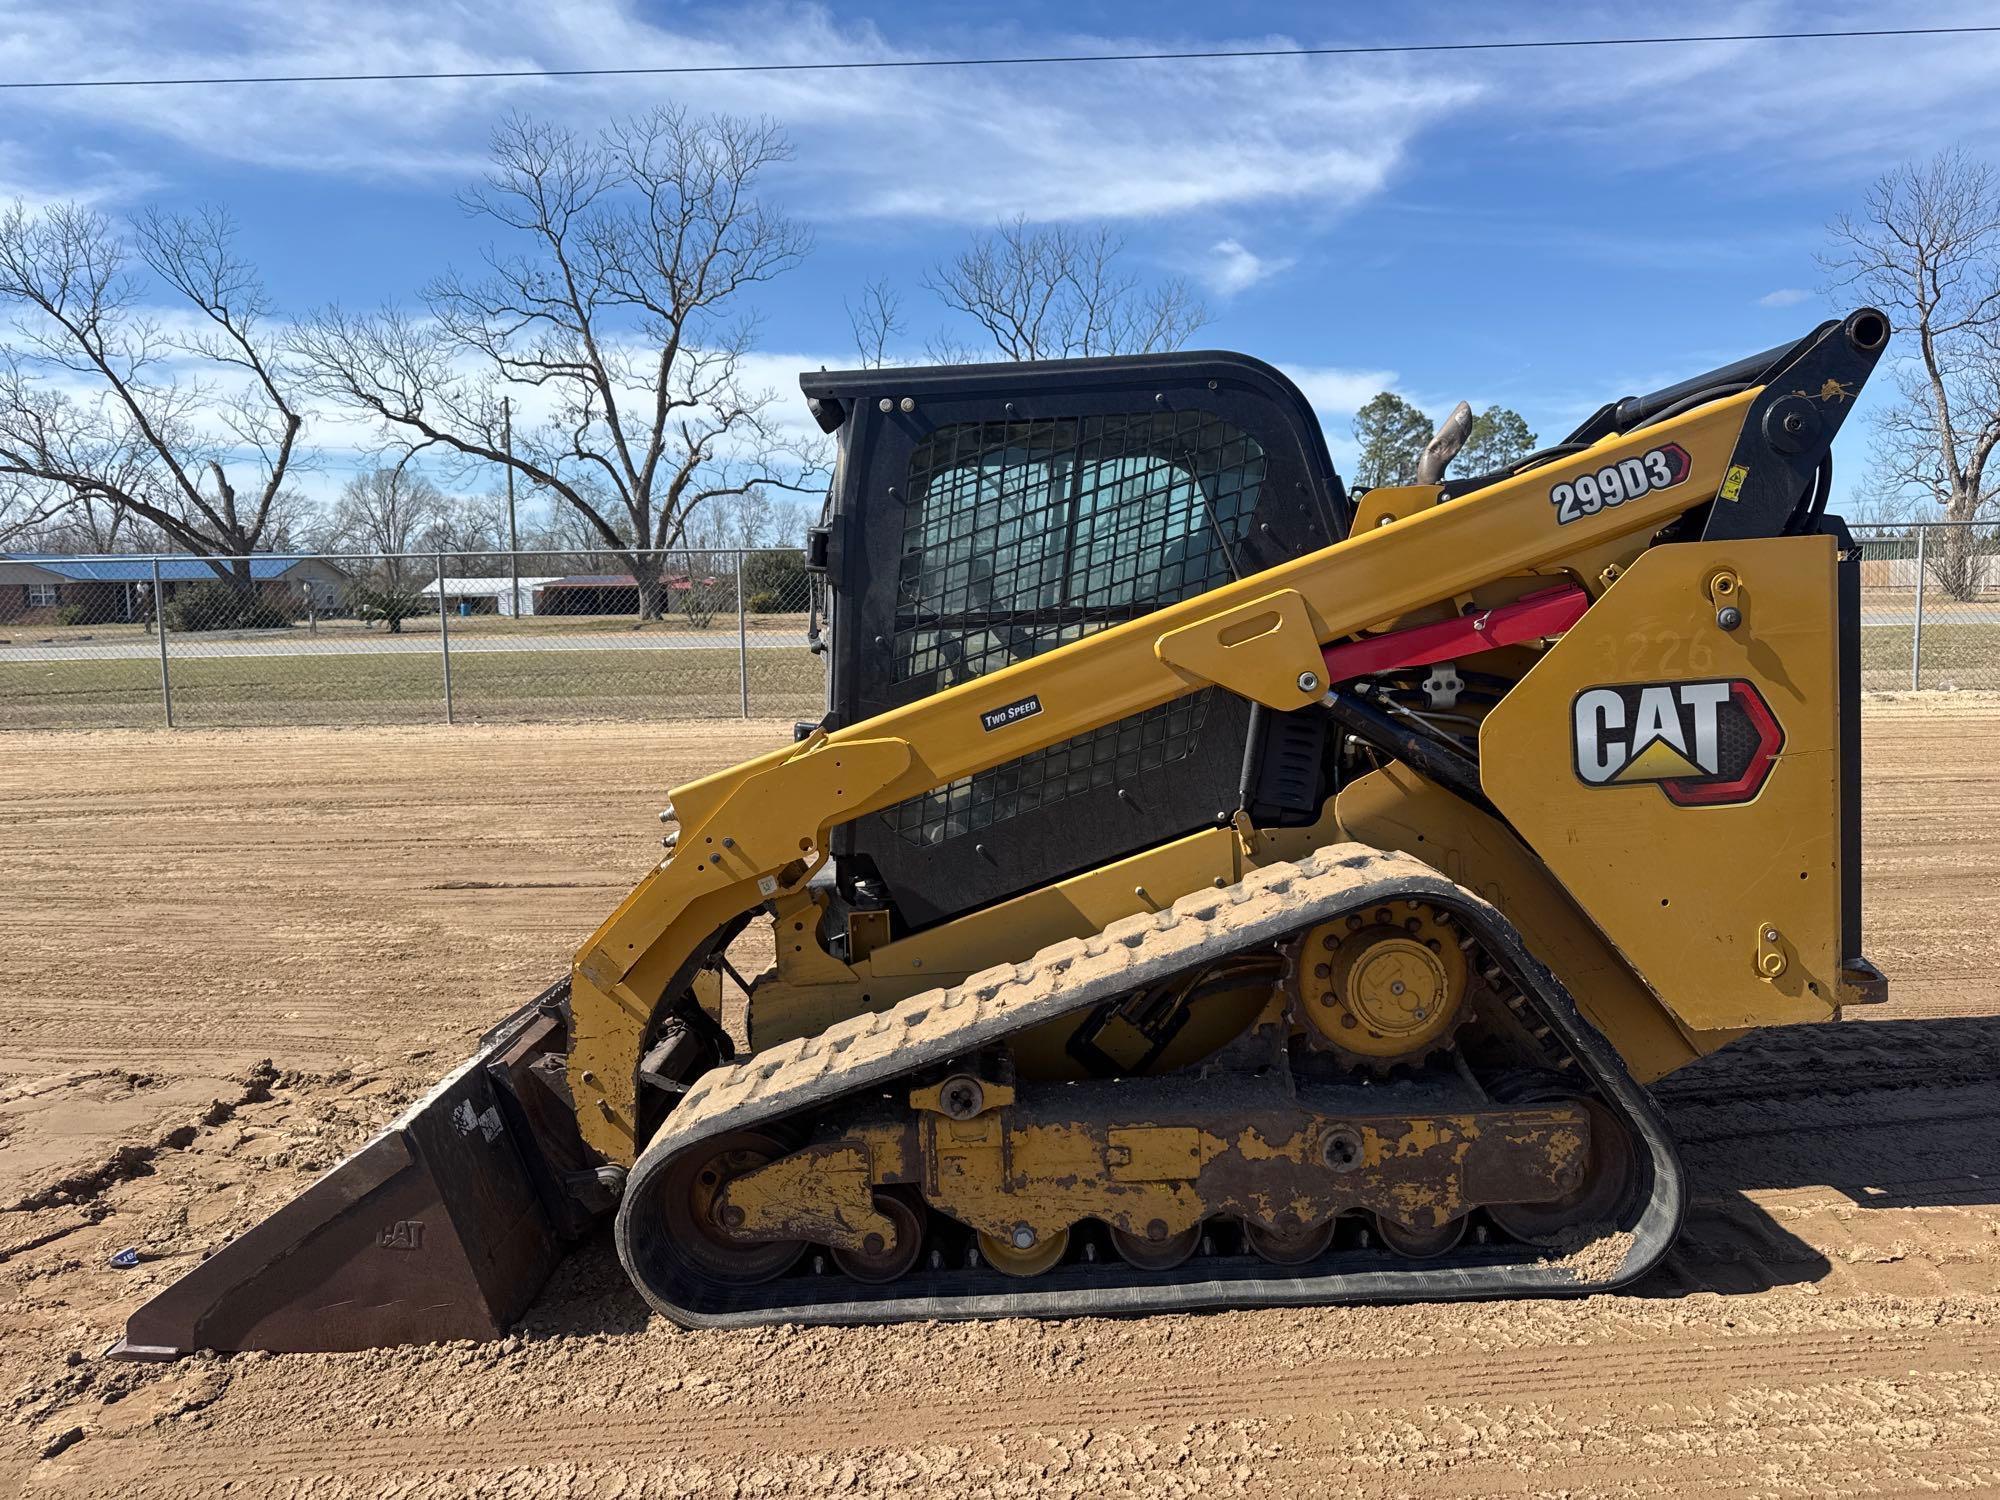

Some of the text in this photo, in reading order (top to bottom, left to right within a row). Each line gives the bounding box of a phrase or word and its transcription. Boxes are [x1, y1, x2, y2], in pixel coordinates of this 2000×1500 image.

[1552, 451, 1672, 523] 299D3
[1575, 682, 1730, 782] CAT
[376, 1220, 424, 1249] CAT
